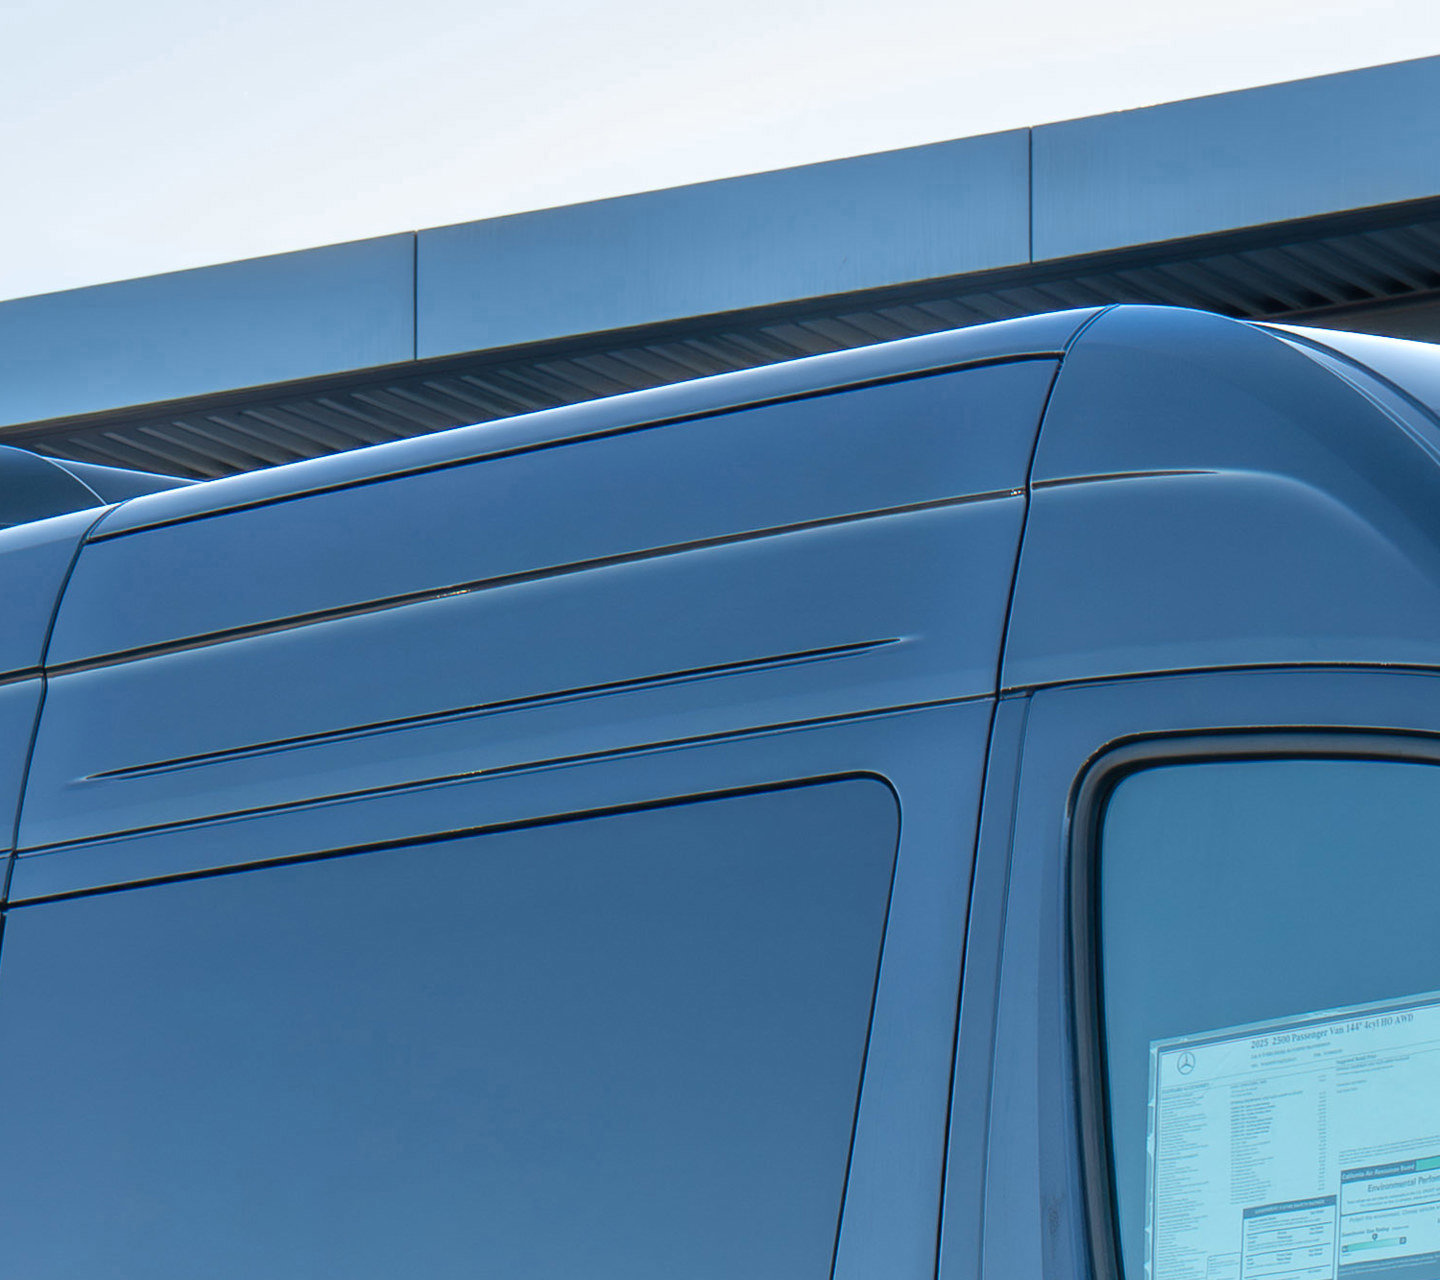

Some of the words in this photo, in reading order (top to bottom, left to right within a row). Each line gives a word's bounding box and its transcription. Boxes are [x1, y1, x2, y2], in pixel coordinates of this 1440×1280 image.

[1292, 1030, 1328, 1042] Passenger
[1330, 1026, 1344, 1036] Van
[1394, 1013, 1414, 1025] AWD
